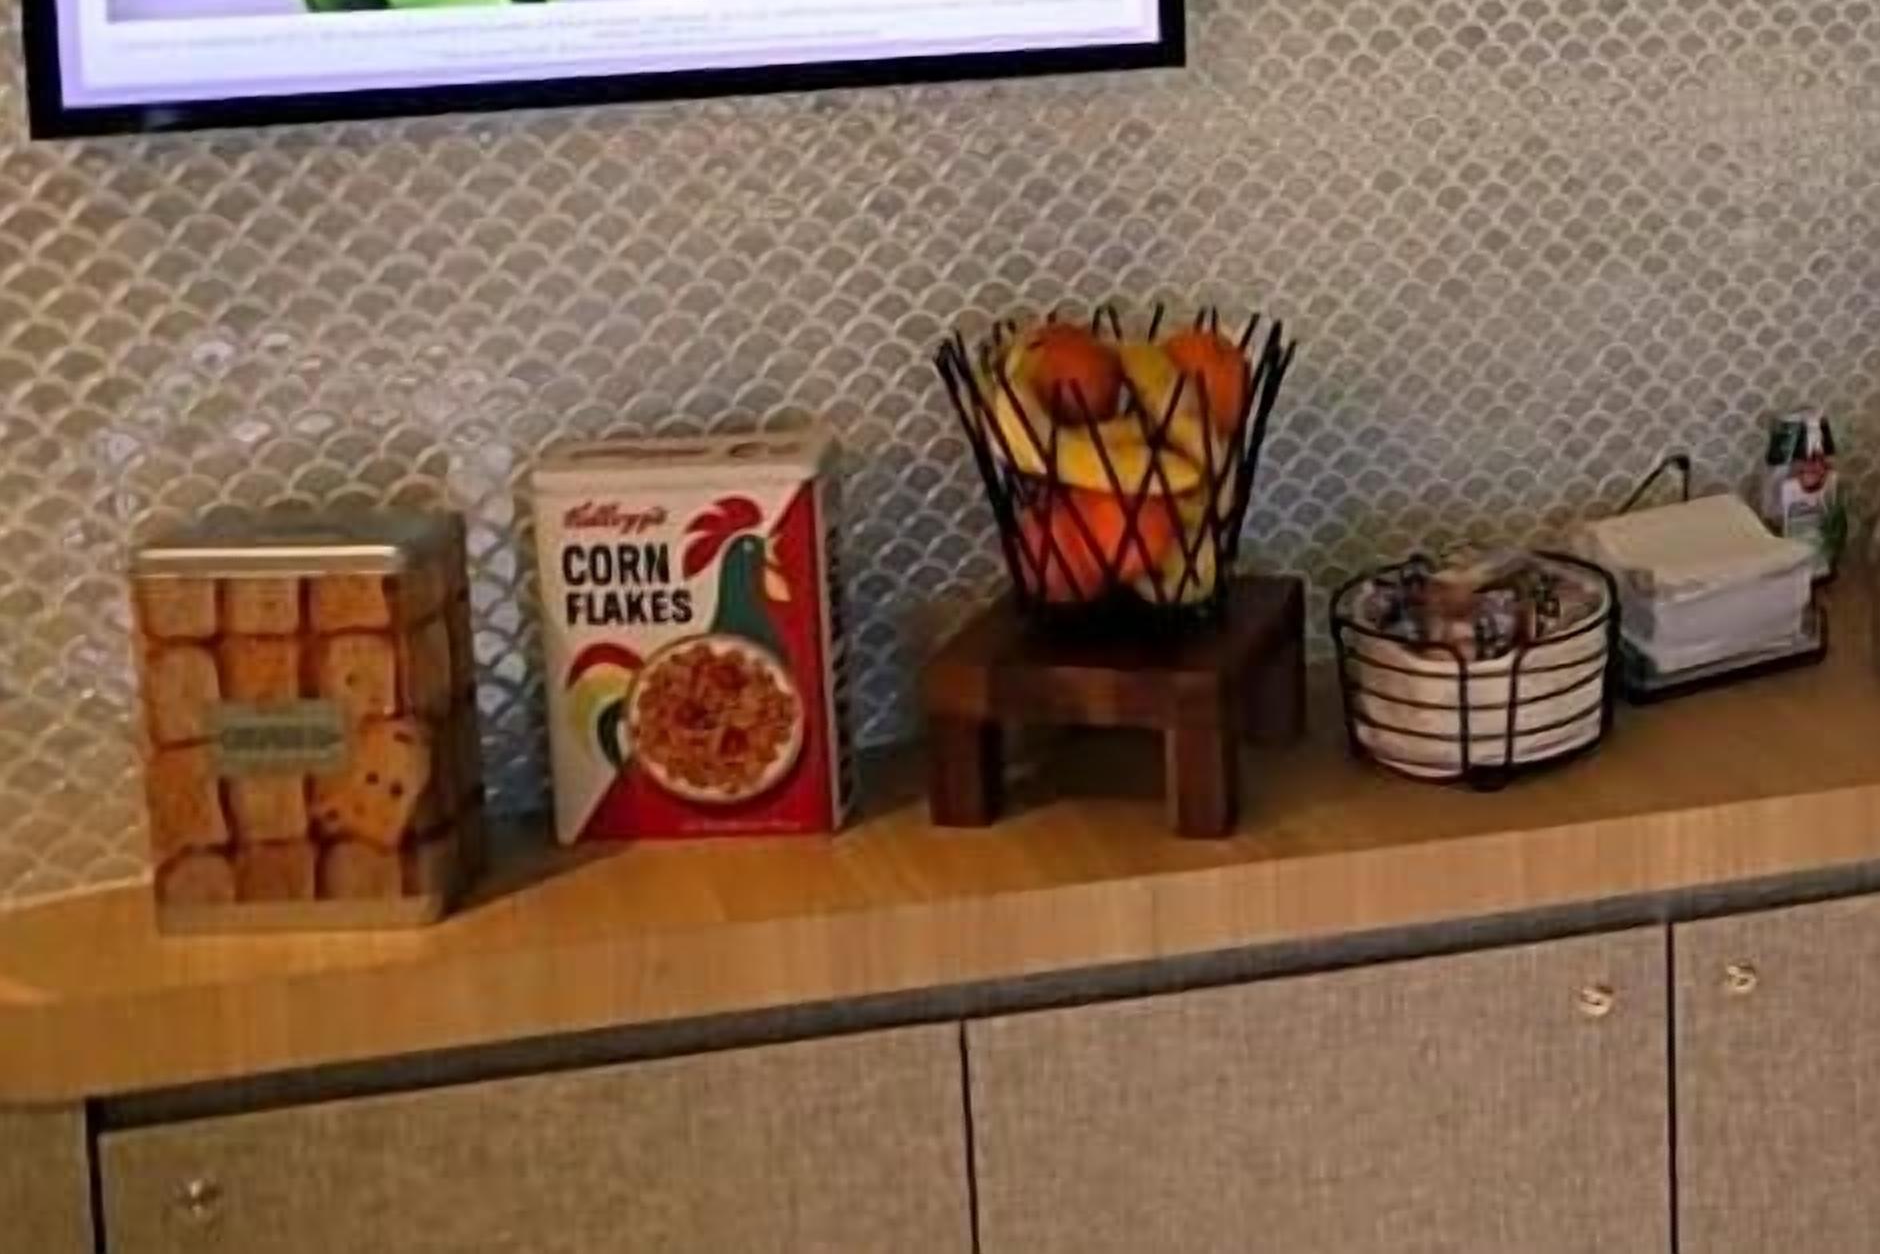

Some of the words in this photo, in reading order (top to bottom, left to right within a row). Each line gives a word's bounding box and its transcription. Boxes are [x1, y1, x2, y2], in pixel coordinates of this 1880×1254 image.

[564, 500, 668, 534] Kellogg's
[562, 543, 670, 587] CORN
[567, 588, 694, 627] FLAKES
